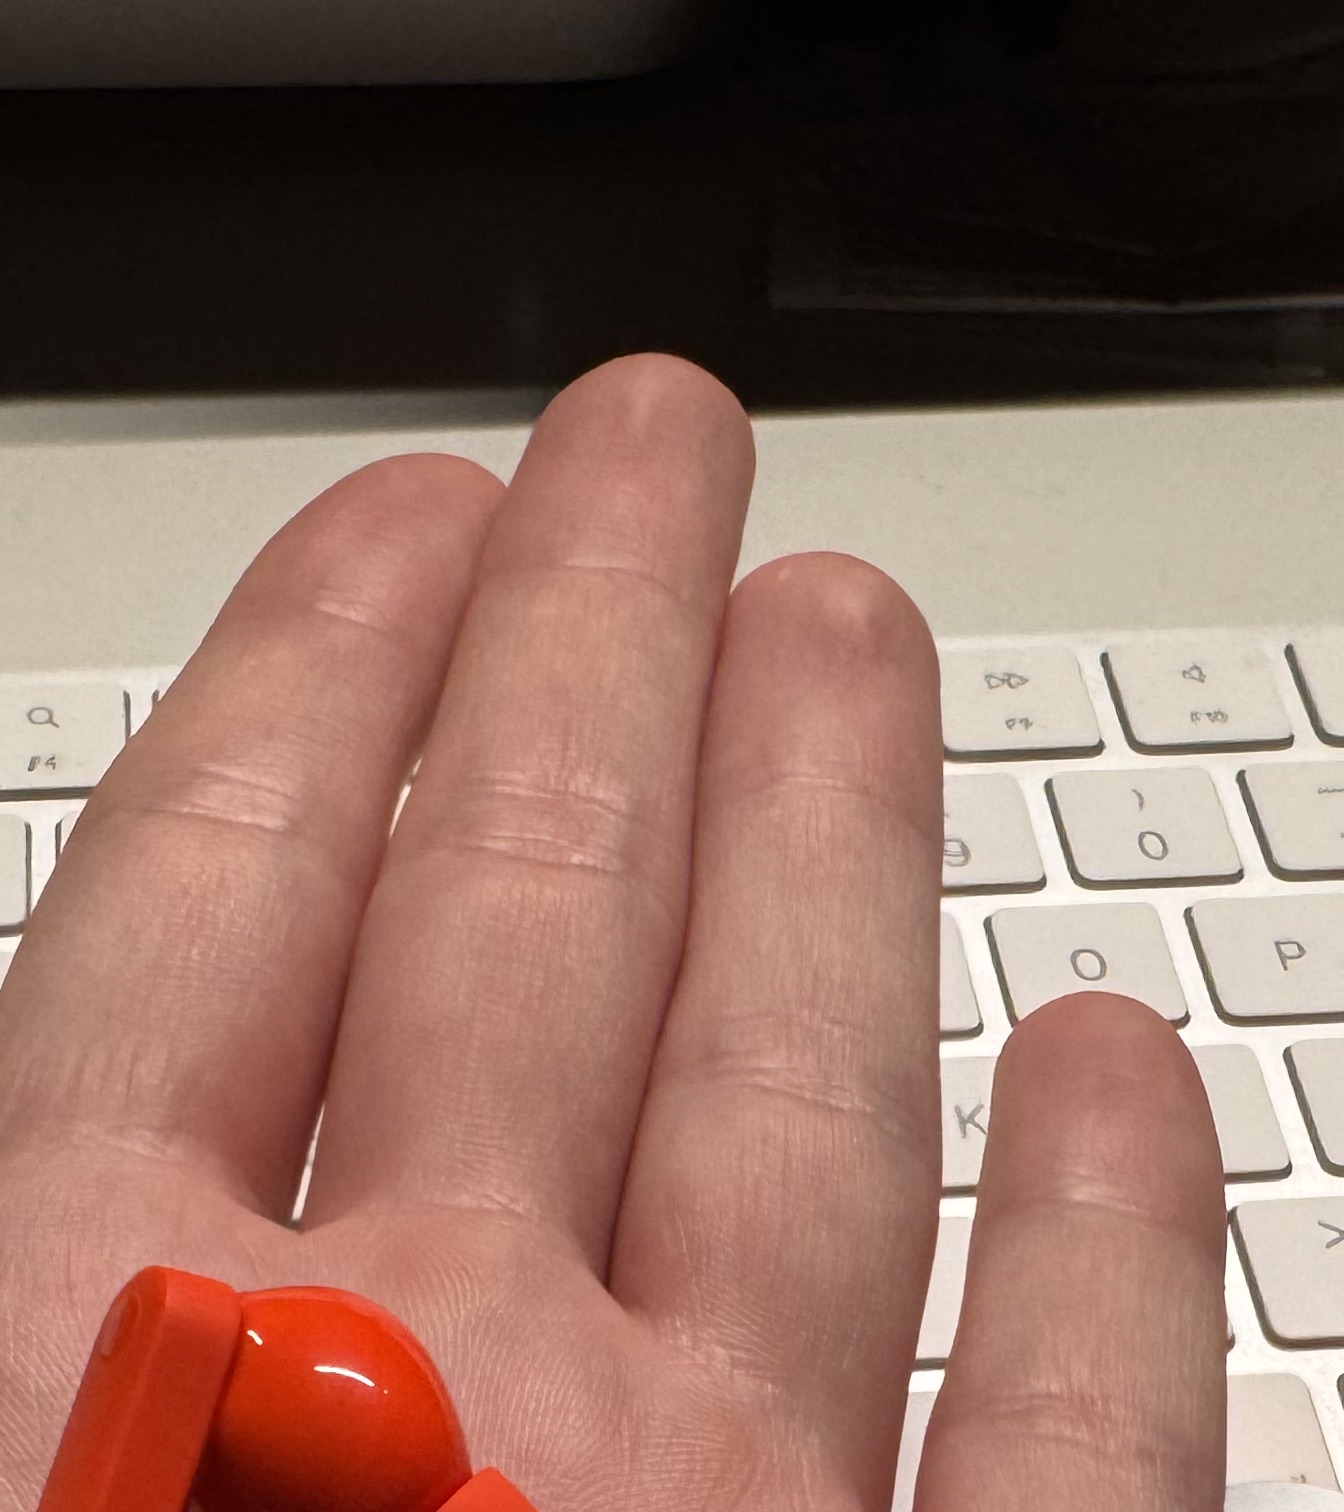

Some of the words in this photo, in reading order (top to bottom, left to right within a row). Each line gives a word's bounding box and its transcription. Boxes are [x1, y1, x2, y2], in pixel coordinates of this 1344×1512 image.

[1070, 949, 1107, 981] O
[1275, 944, 1306, 971] P
[955, 1104, 986, 1138] K
